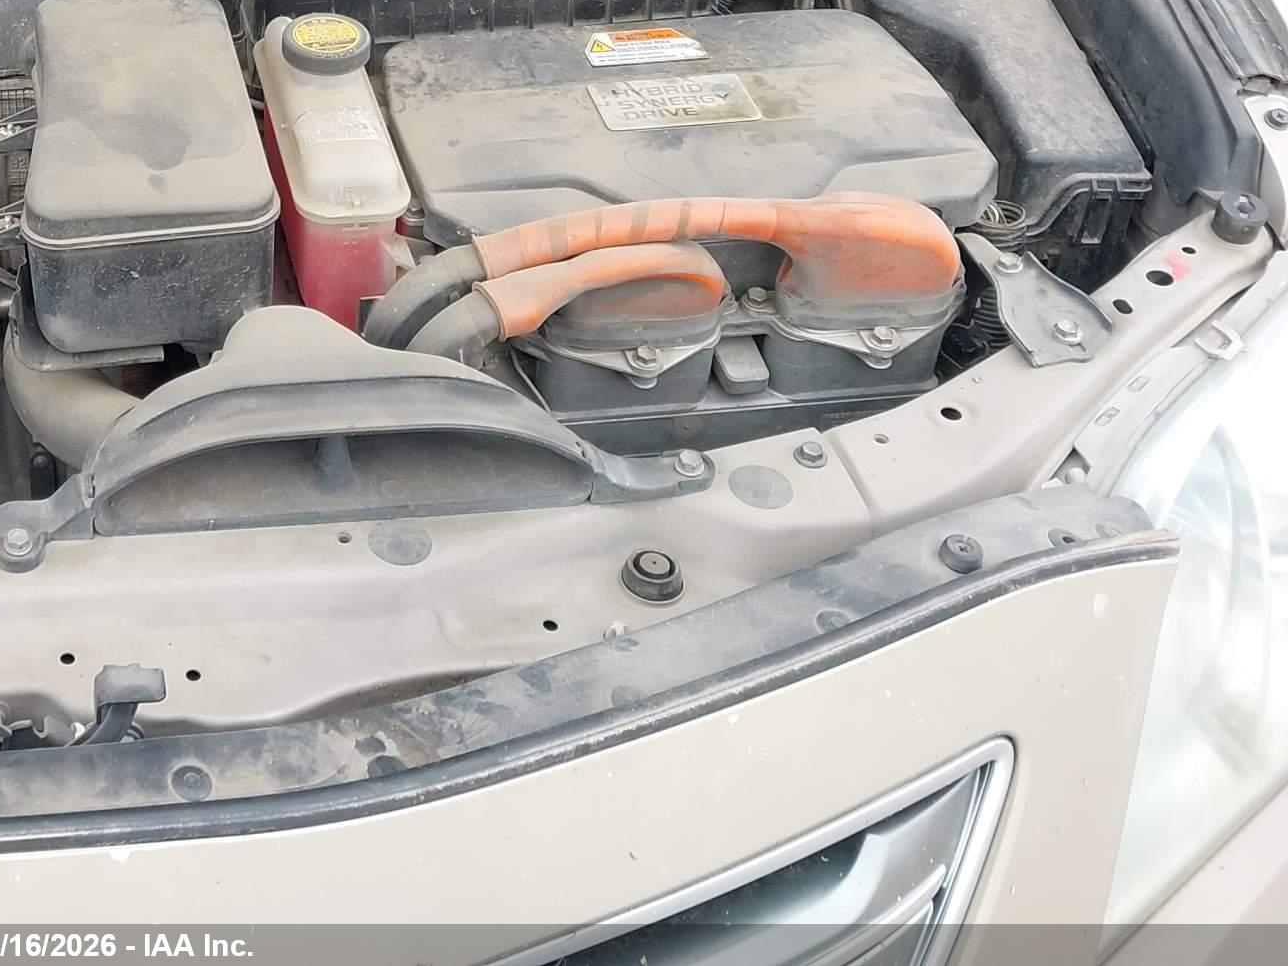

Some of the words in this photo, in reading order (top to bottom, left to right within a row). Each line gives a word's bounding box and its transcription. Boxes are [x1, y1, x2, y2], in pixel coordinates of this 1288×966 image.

[614, 84, 704, 100] HYBRID
[618, 91, 730, 110] SYNERGY
[623, 106, 700, 121] DRIVE
